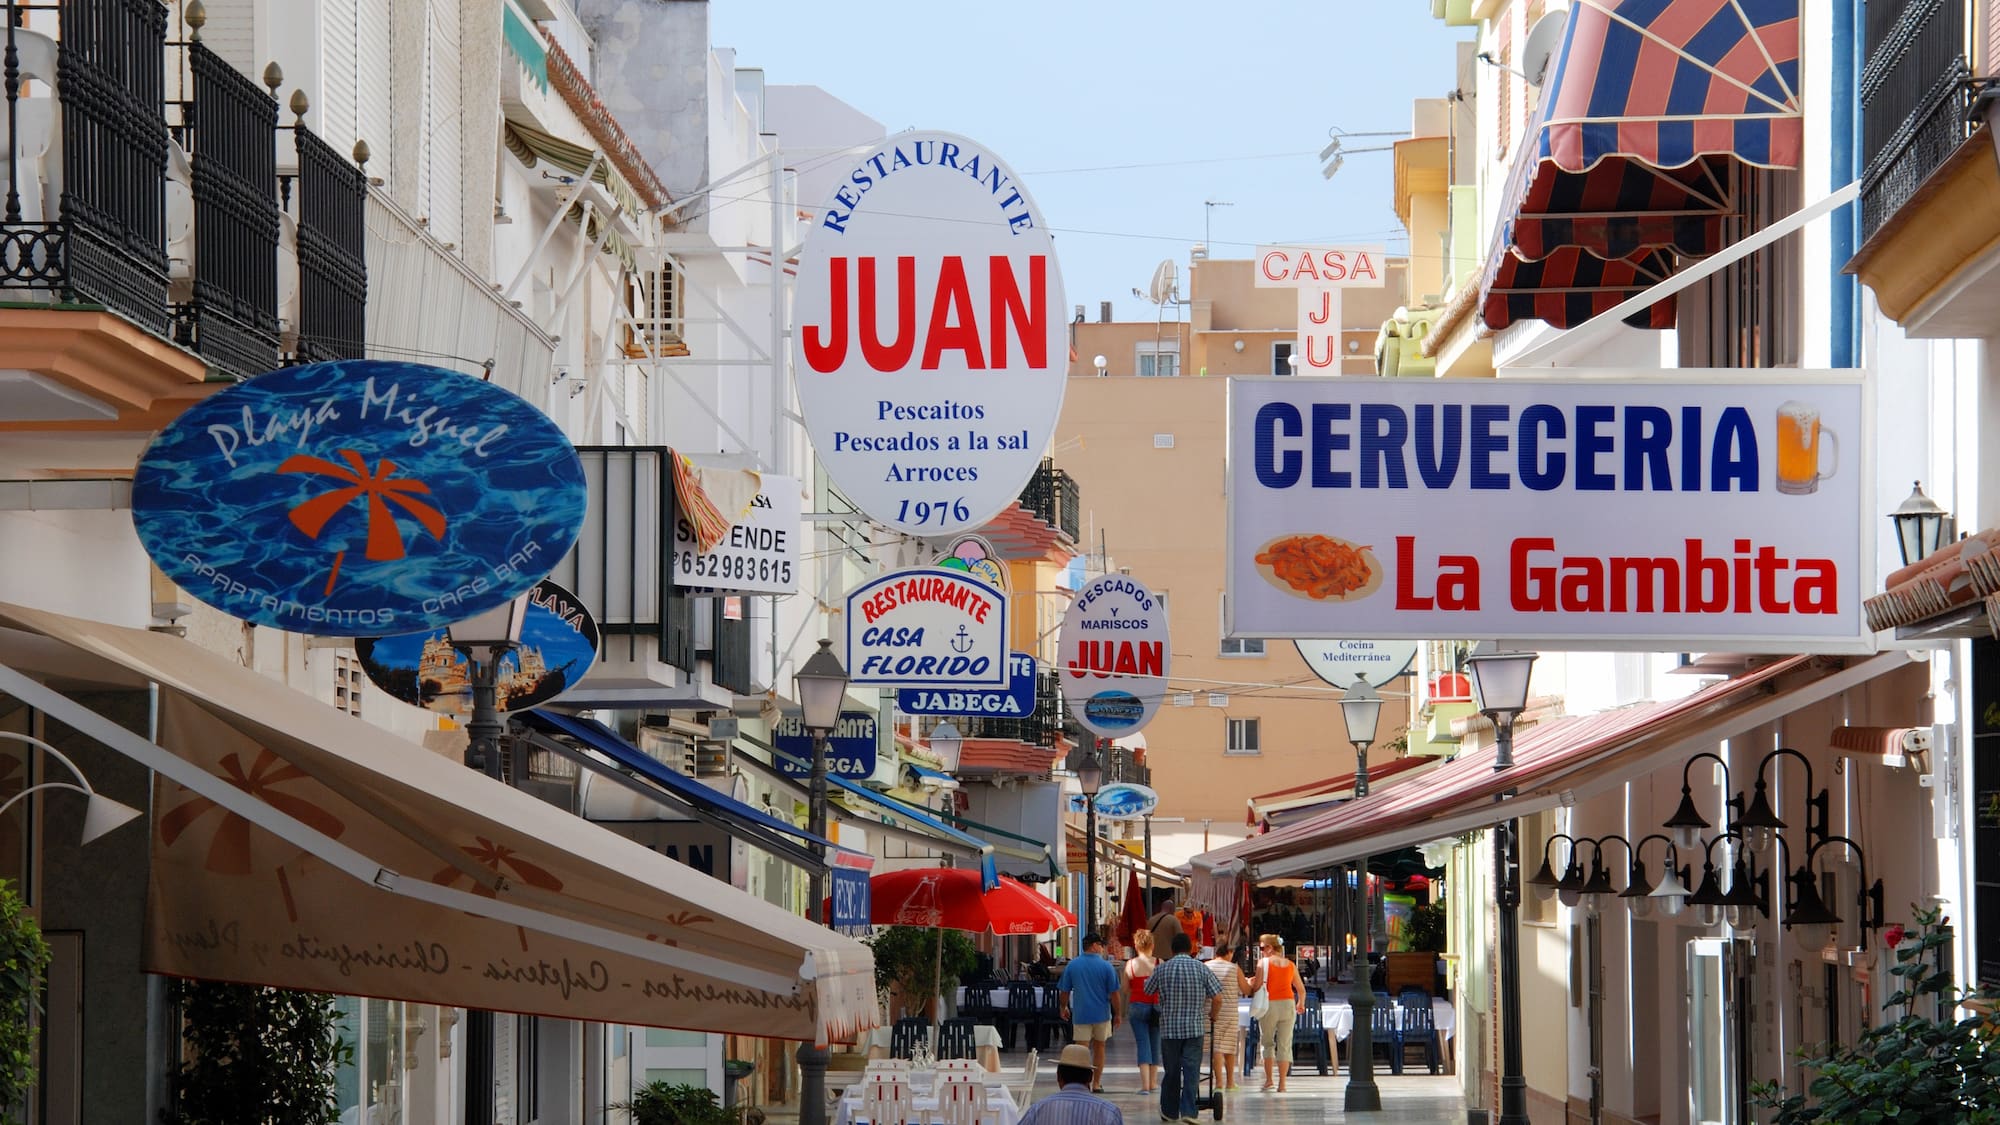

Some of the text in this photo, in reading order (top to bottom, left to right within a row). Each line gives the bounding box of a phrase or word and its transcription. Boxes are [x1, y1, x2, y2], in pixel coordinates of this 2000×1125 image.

[822, 140, 1033, 236] RESTAURANTE
[1263, 252, 1376, 280] CASA
[802, 255, 1047, 373] JUAN
[208, 376, 509, 467] Playa Miguel
[878, 400, 985, 420] Pescaitos
[834, 431, 1029, 451] Pescados a la sal
[1254, 402, 1760, 492] CERVECERIA
[885, 463, 978, 481] Arroces
[896, 496, 970, 526] 1976
[182, 553, 395, 624] APARTAMENTOS
[422, 576, 490, 614] CAFÉ
[494, 540, 542, 582] BAR
[681, 551, 791, 584] 652983615
[1396, 535, 1839, 614] La Gambita
[530, 587, 584, 632] LAYA
[861, 578, 991, 624] RESTAURANTE
[1078, 580, 1152, 612] PESCADOS
[1081, 619, 1148, 630] MARISCOS
[1110, 607, 1119, 617] Y
[862, 627, 924, 647] CASA
[1339, 640, 1374, 650] Cocina
[861, 655, 990, 676] FLORIDO
[1068, 640, 1163, 678] JUAN
[1323, 652, 1391, 662] Mediterránea
[911, 692, 1021, 713] JABEGA
